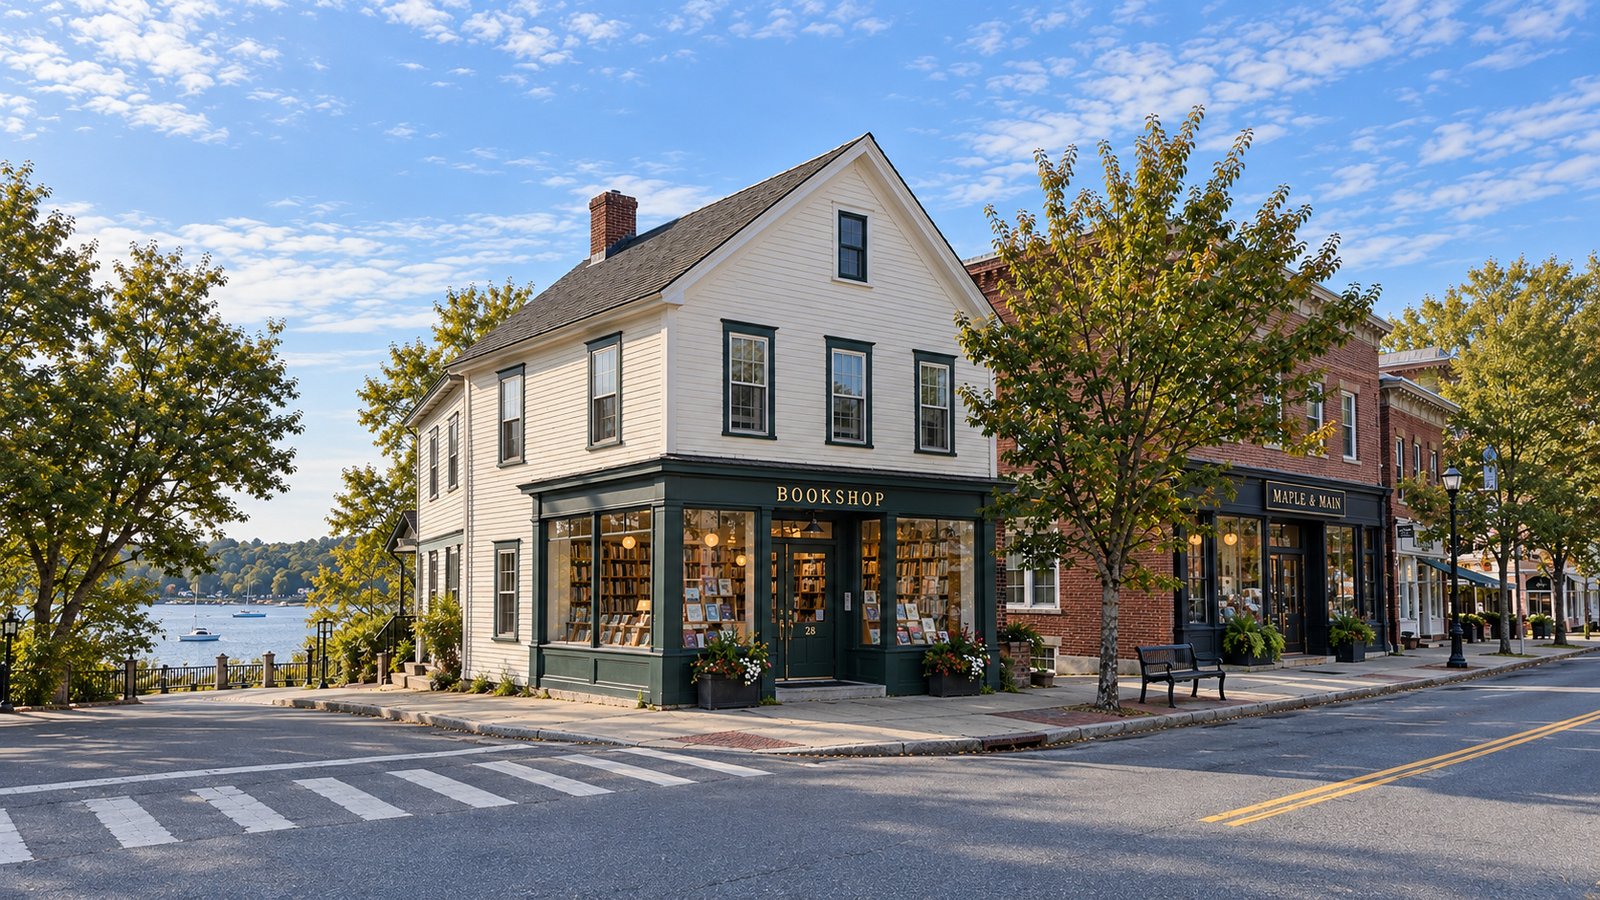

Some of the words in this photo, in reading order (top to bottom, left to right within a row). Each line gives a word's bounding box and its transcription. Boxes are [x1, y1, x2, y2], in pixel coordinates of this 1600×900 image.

[777, 486, 884, 506] BOOKSHOP
[1273, 489, 1306, 506] MAPLE
[1309, 494, 1315, 506] &
[1319, 495, 1341, 509] MAIN
[805, 626, 816, 635] 28
